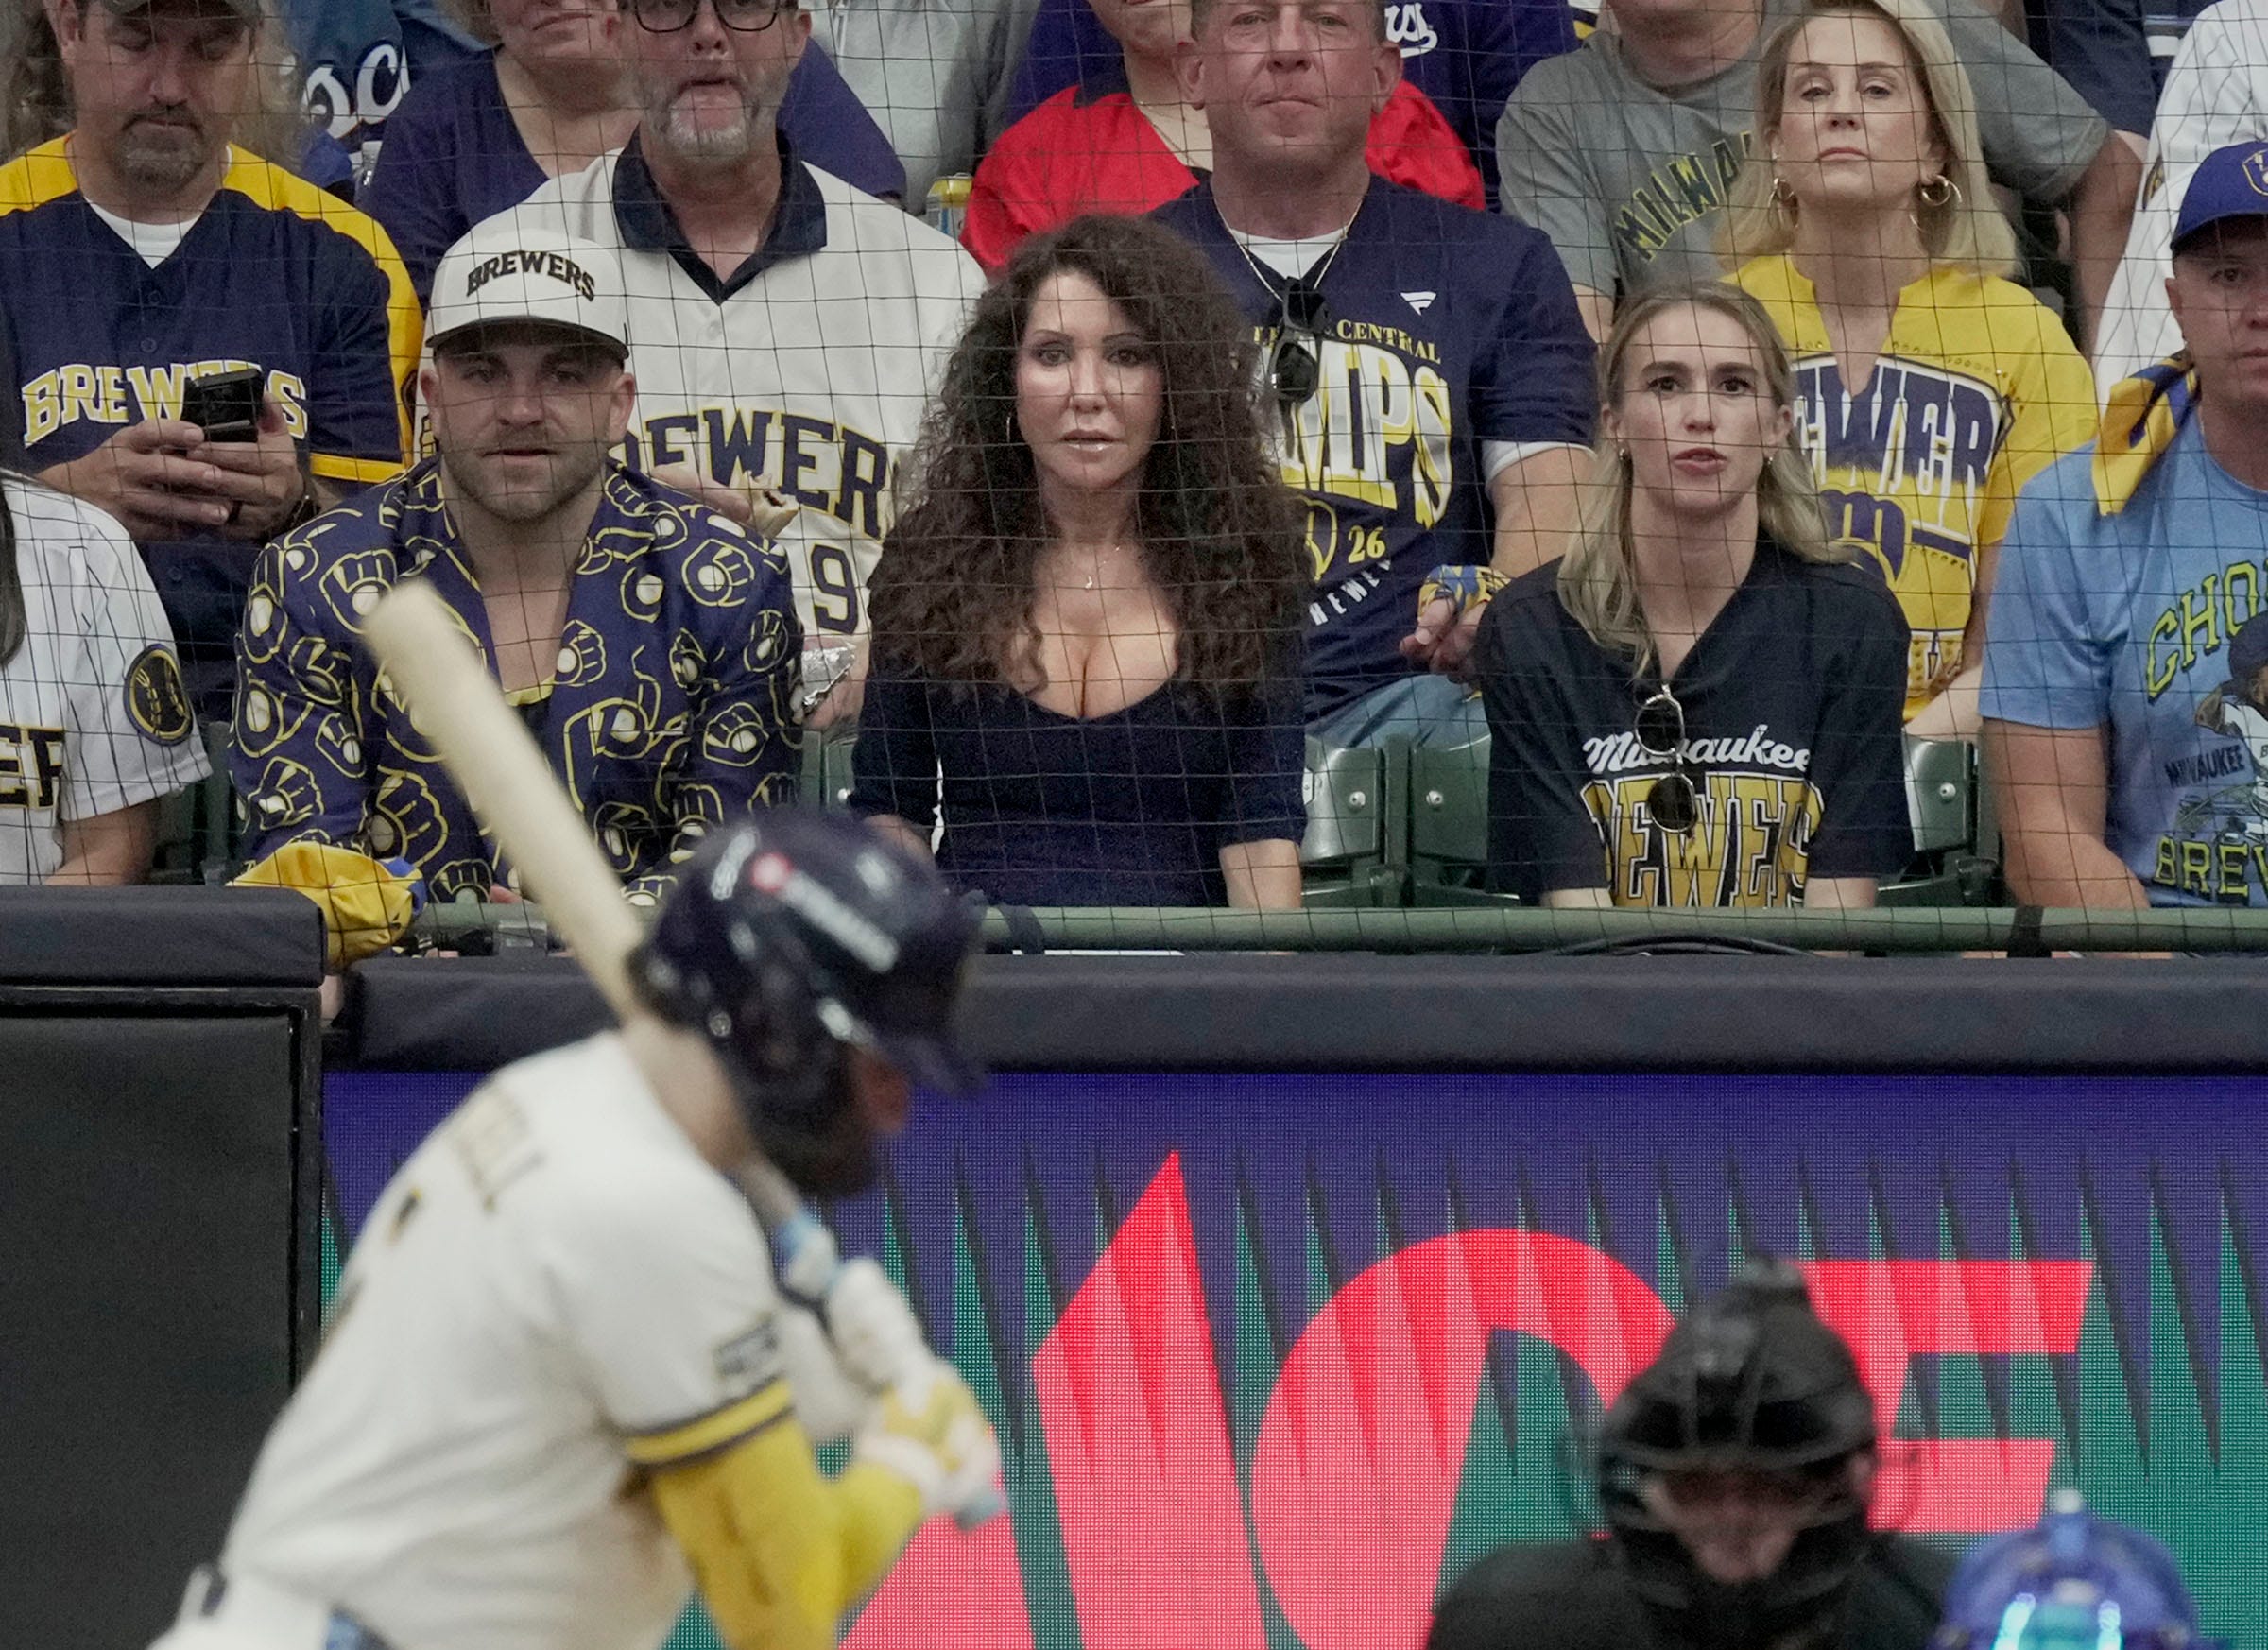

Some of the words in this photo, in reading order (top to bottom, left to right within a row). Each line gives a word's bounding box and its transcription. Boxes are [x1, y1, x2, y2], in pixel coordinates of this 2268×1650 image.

[467, 249, 594, 302] BREWERS
[1337, 318, 1441, 365] CENTRAL
[21, 360, 308, 449] BREWS
[620, 406, 895, 546] EWER
[1348, 524, 1386, 564] 26
[811, 543, 859, 635] 9
[2146, 558, 2268, 706] CHO
[1582, 724, 1812, 774] Miaukee
